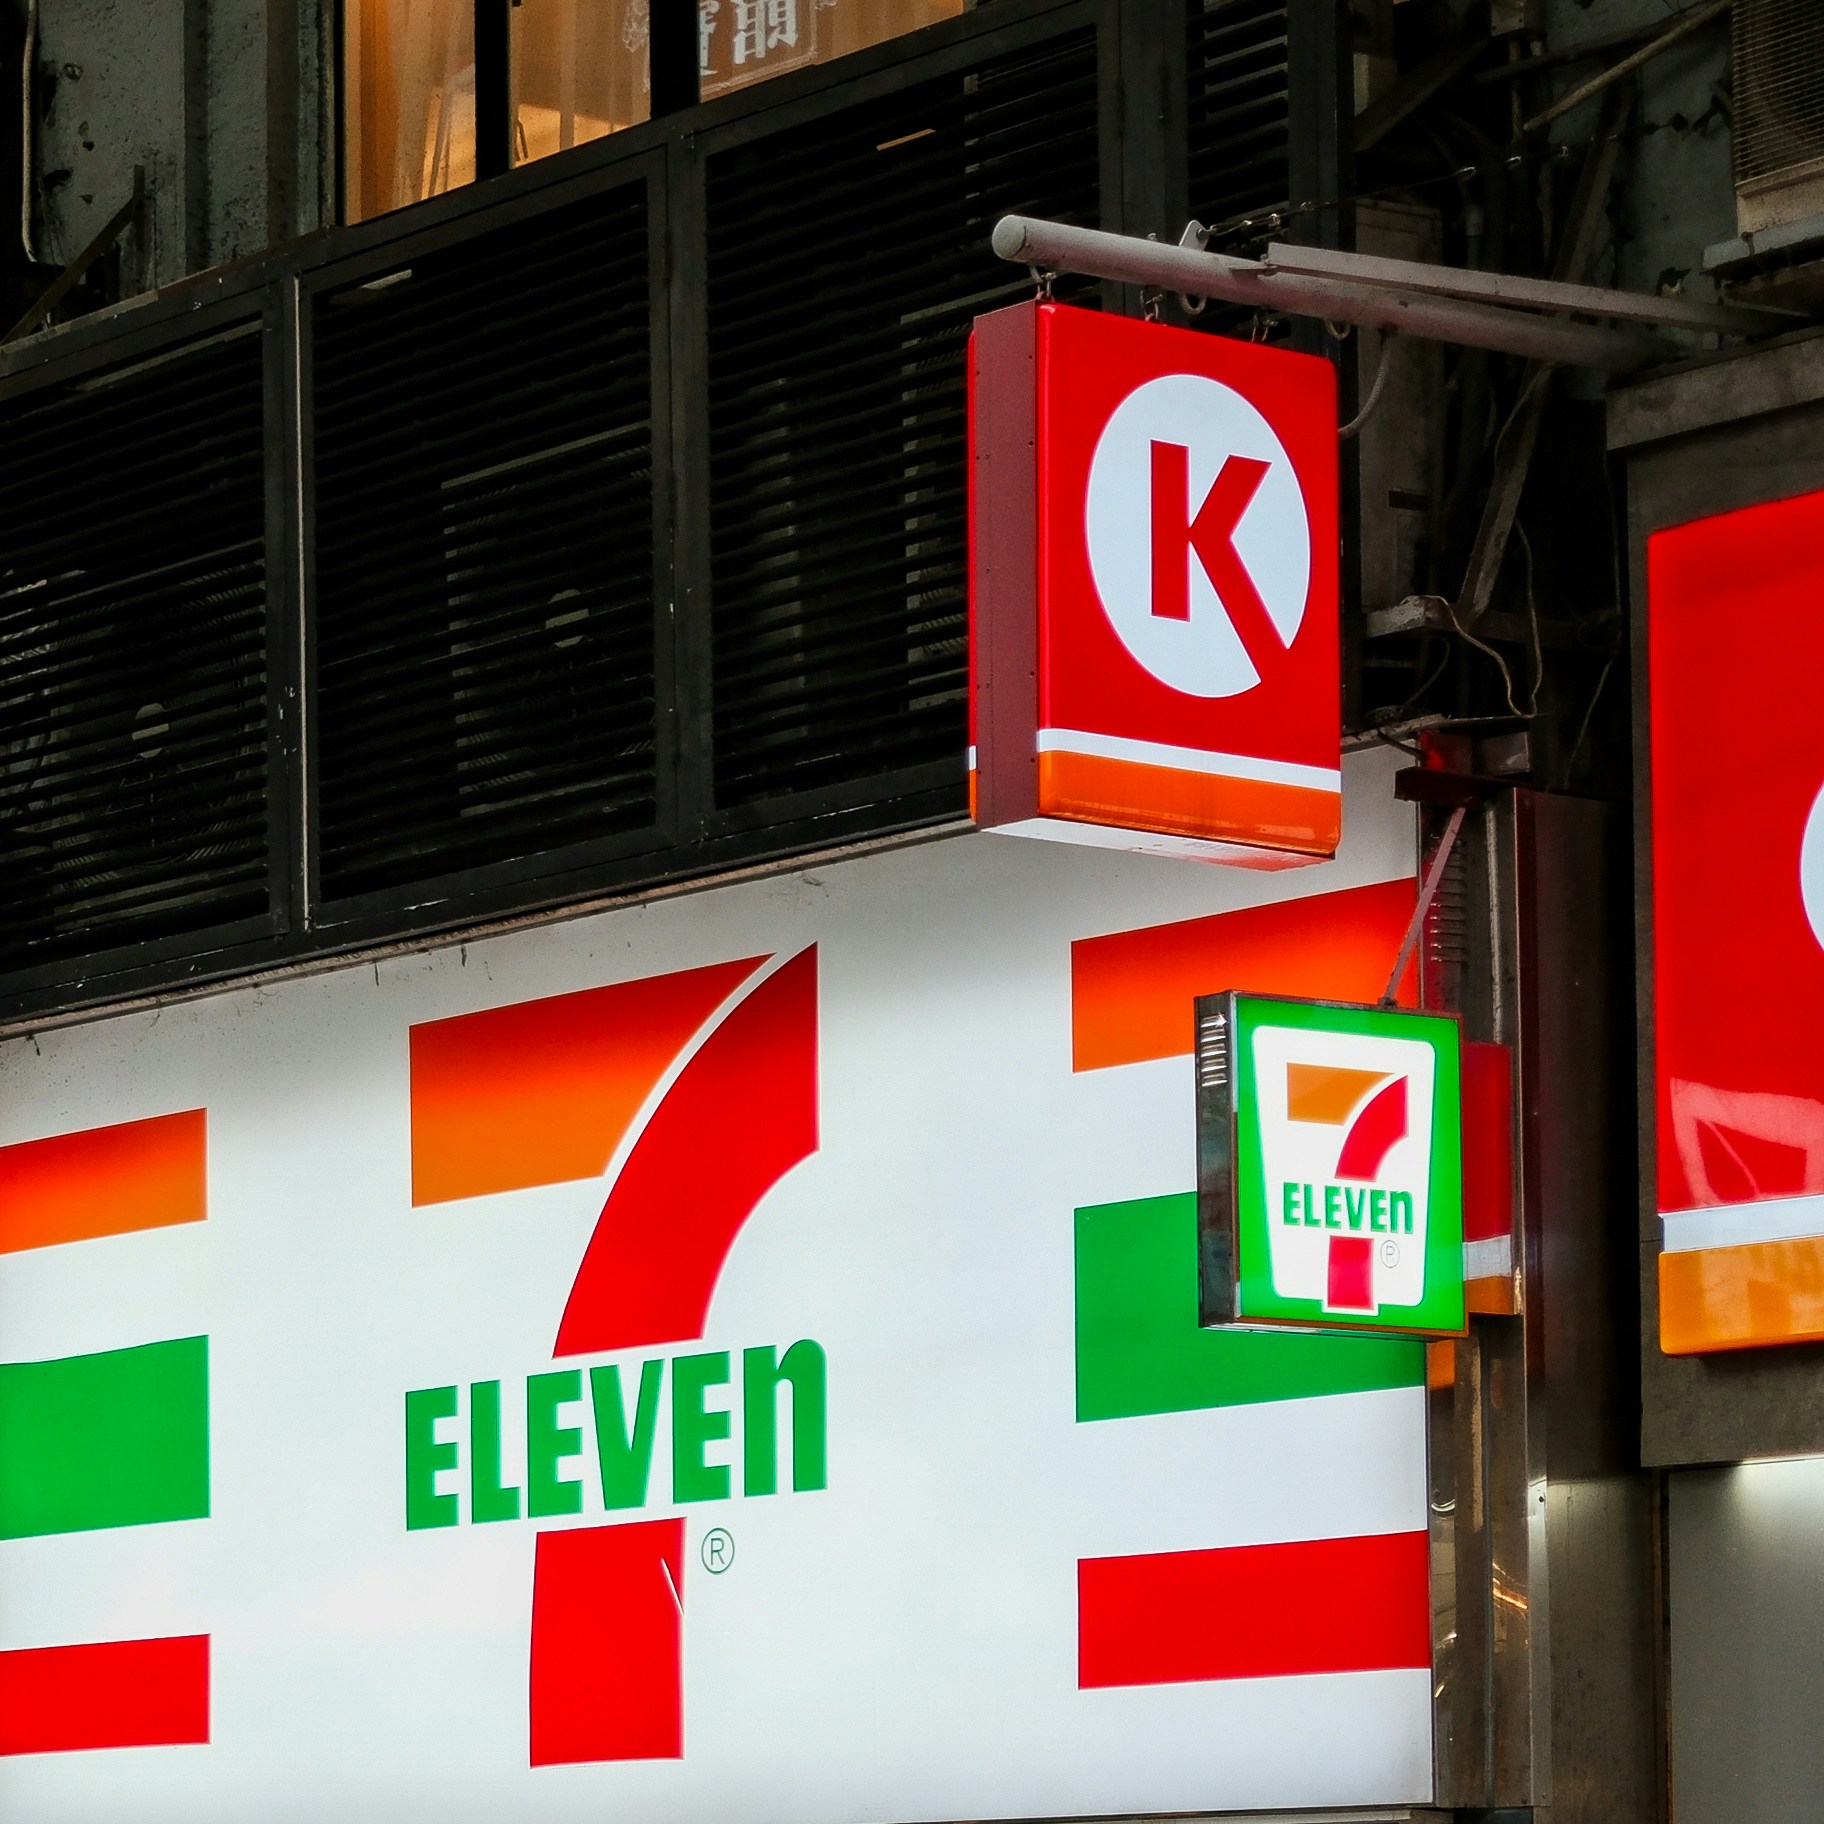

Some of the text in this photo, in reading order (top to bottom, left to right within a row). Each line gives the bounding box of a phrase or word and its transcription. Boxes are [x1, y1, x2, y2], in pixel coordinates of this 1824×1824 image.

[1150, 440, 1292, 672] K
[1285, 1063, 1408, 1312] 7
[410, 942, 819, 1768] 7
